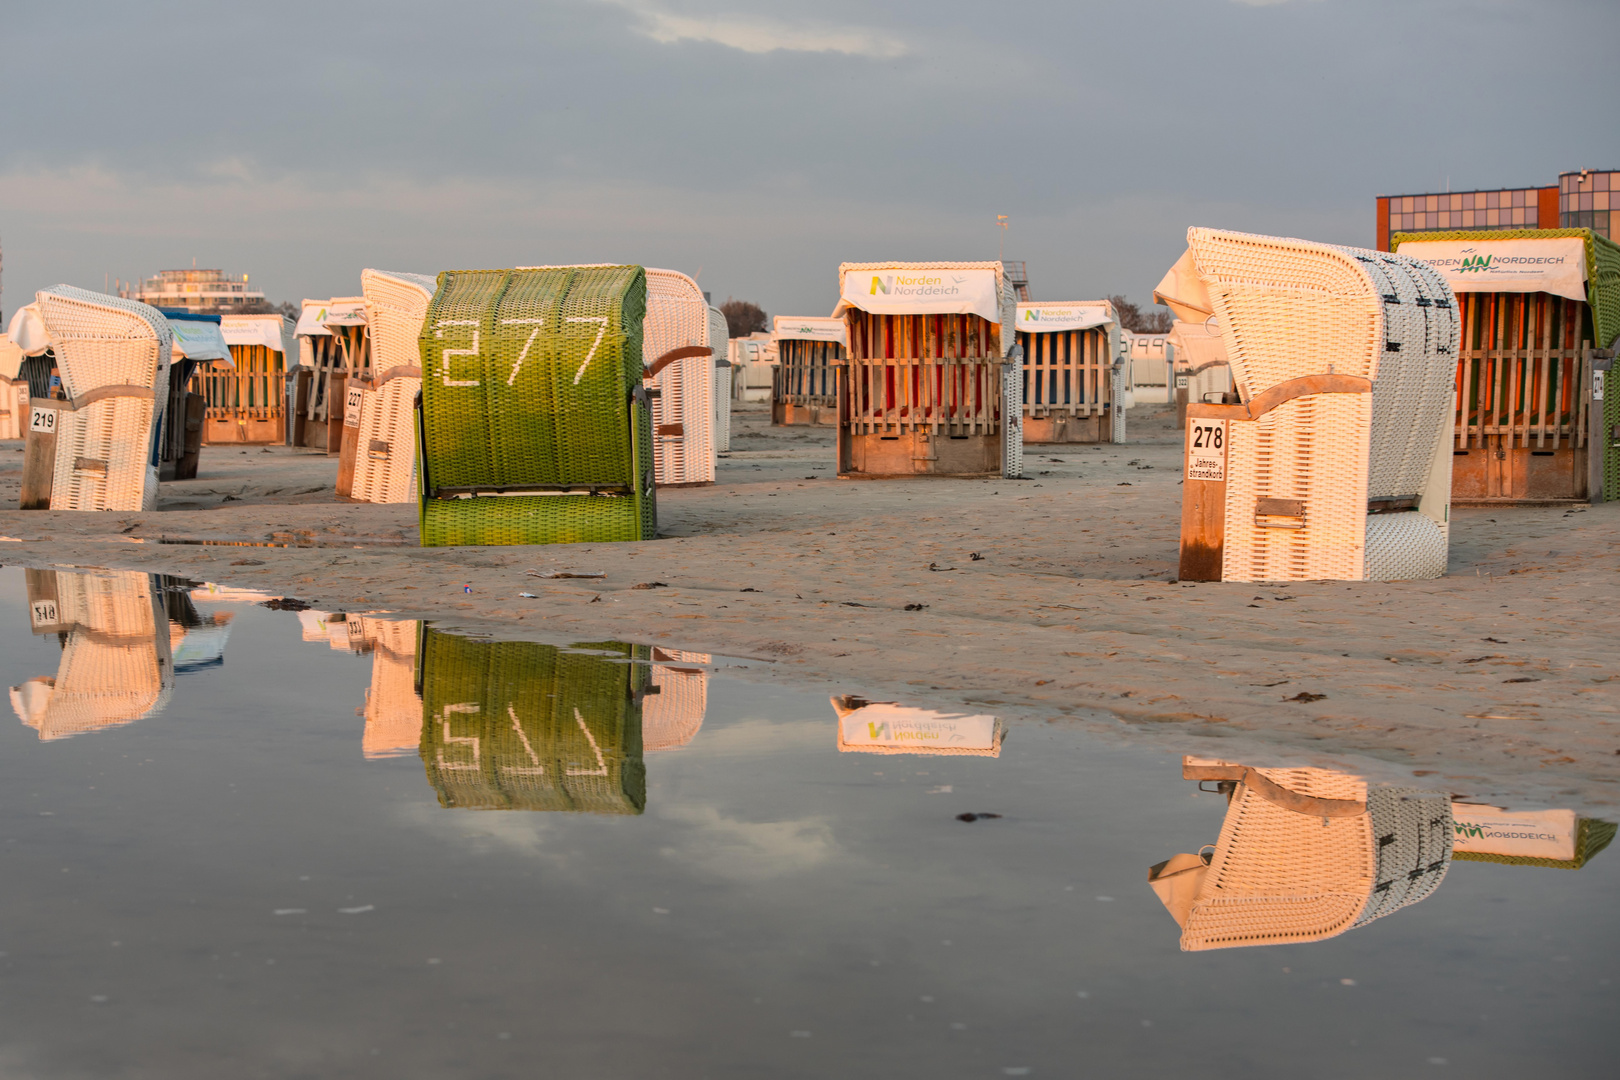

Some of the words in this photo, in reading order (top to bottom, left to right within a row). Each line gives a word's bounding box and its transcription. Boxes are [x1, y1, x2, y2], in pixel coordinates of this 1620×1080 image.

[1493, 256, 1565, 265] NORDDEICH
[895, 275, 942, 286] Norden
[894, 286, 960, 296] Norddeich
[431, 316, 609, 387] 277
[348, 391, 361, 407] 227
[33, 412, 54, 428] 219
[1193, 425, 1223, 449] 278
[1195, 457, 1219, 468] Jahres-
[1189, 469, 1223, 479] strandkorb
